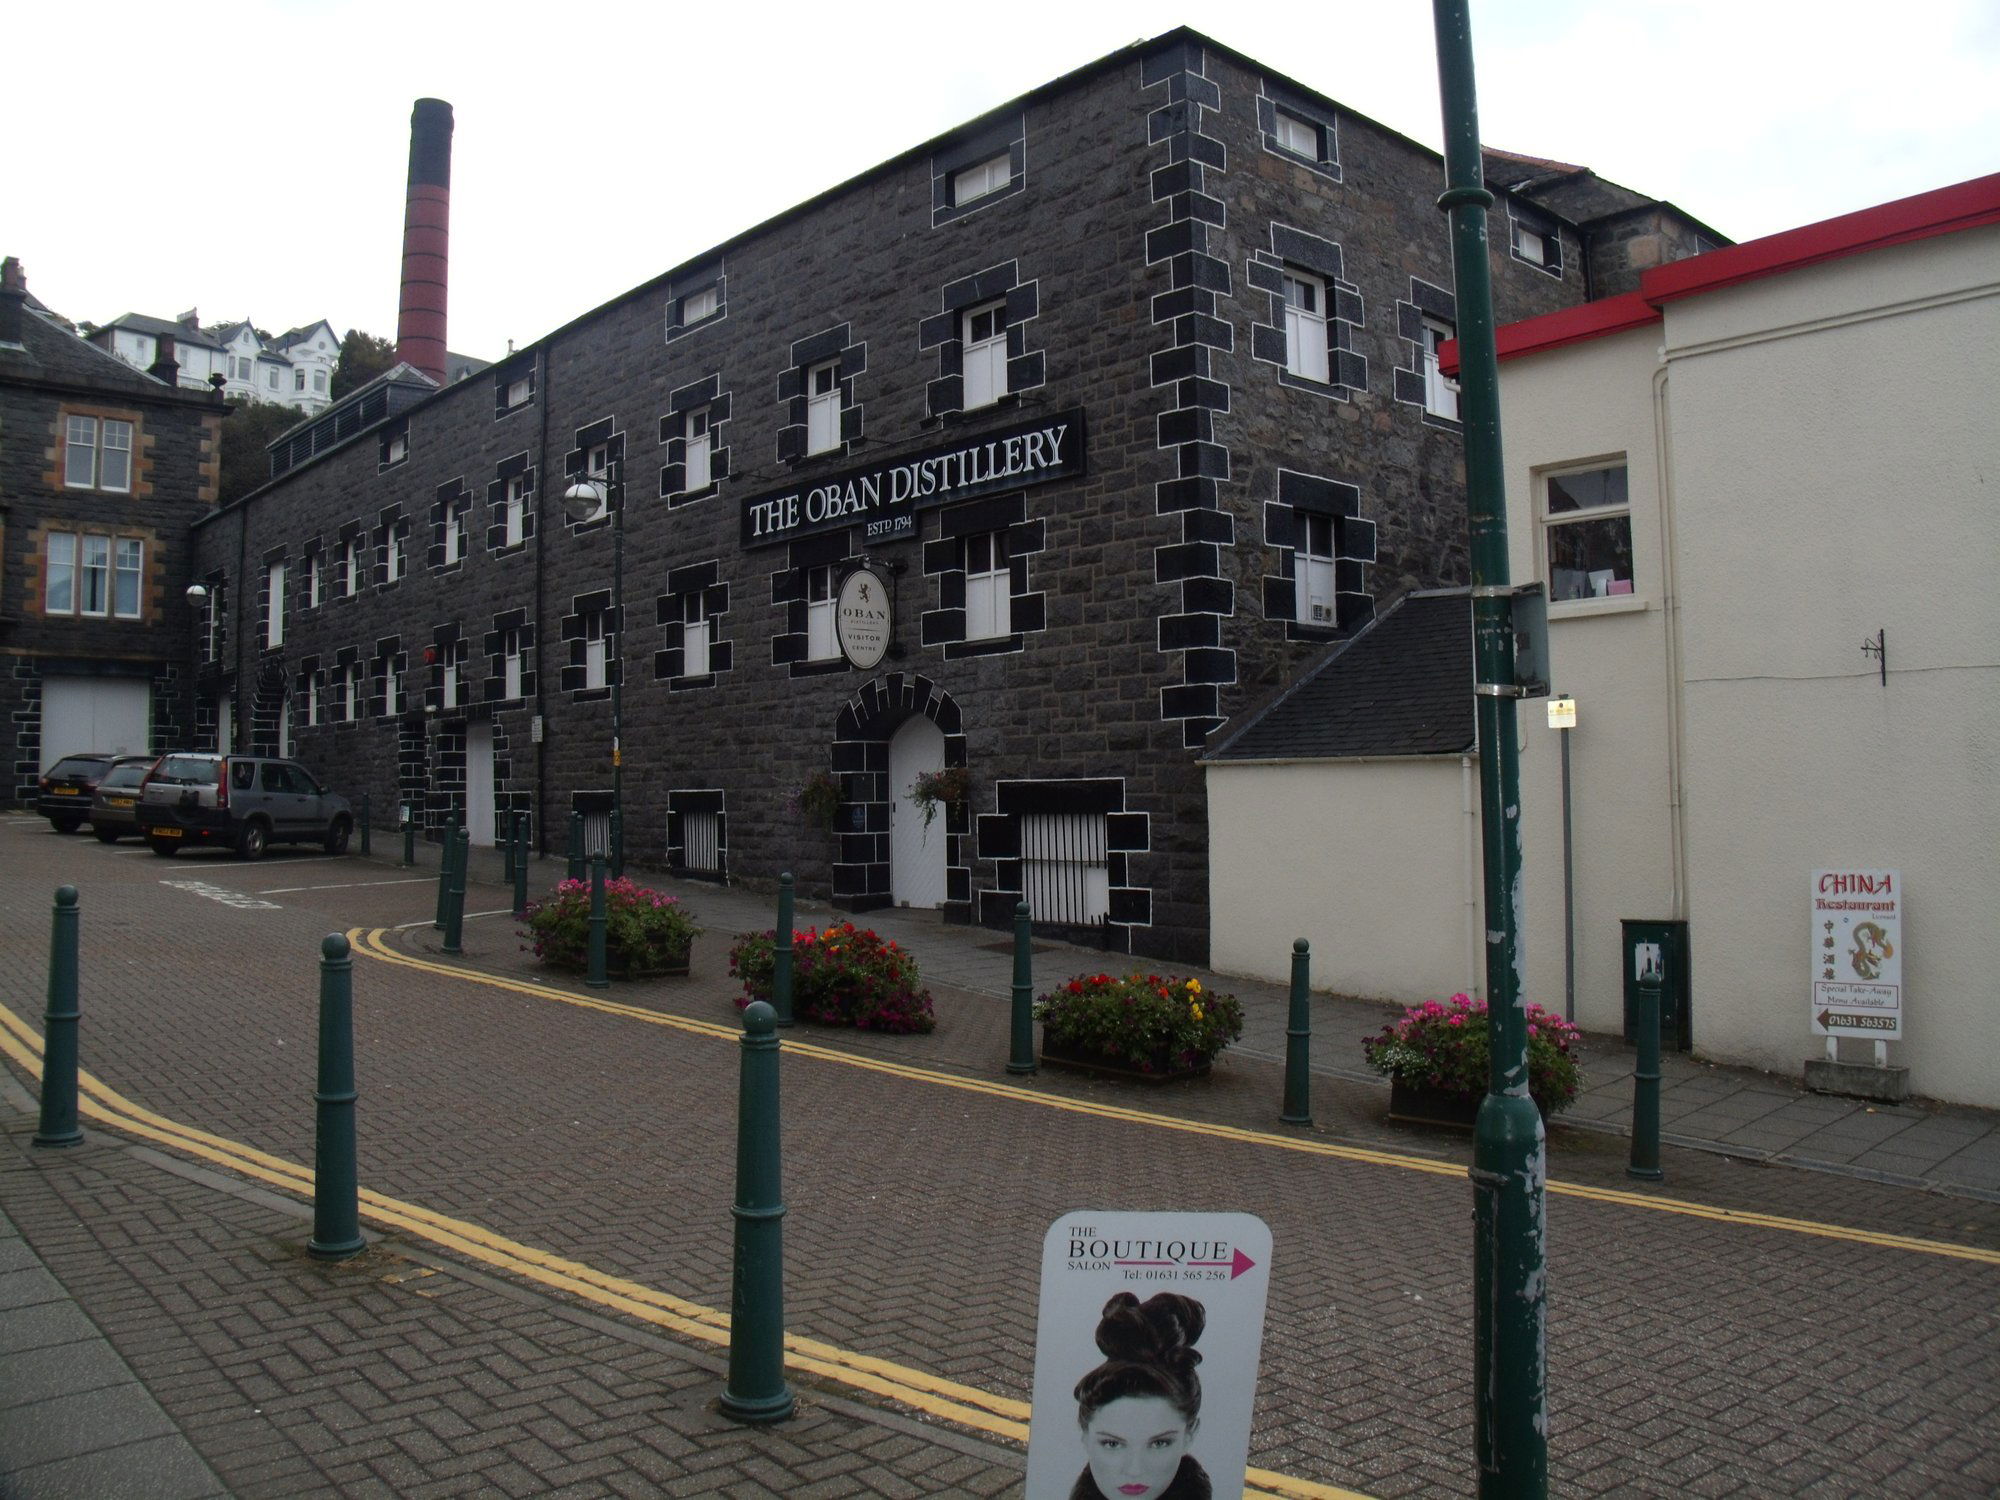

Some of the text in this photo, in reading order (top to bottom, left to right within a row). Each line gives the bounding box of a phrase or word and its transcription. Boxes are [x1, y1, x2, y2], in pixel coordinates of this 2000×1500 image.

[750, 425, 1068, 537] THE OBAN DISTILLERY
[894, 515, 912, 530] 1794
[843, 608, 885, 620] OBAN
[1818, 873, 1892, 895] CHINA
[1815, 898, 1896, 912] Restaurant
[1821, 983, 1847, 993] Special
[1828, 995, 1885, 1006] Menu Available
[1829, 1015, 1896, 1029] 01631 563575
[1069, 1226, 1097, 1237] THE
[1068, 1239, 1228, 1264] BOUTIQUE
[1067, 1261, 1111, 1271] SALON
[1122, 1269, 1226, 1281] Tel: 01631 565 256
